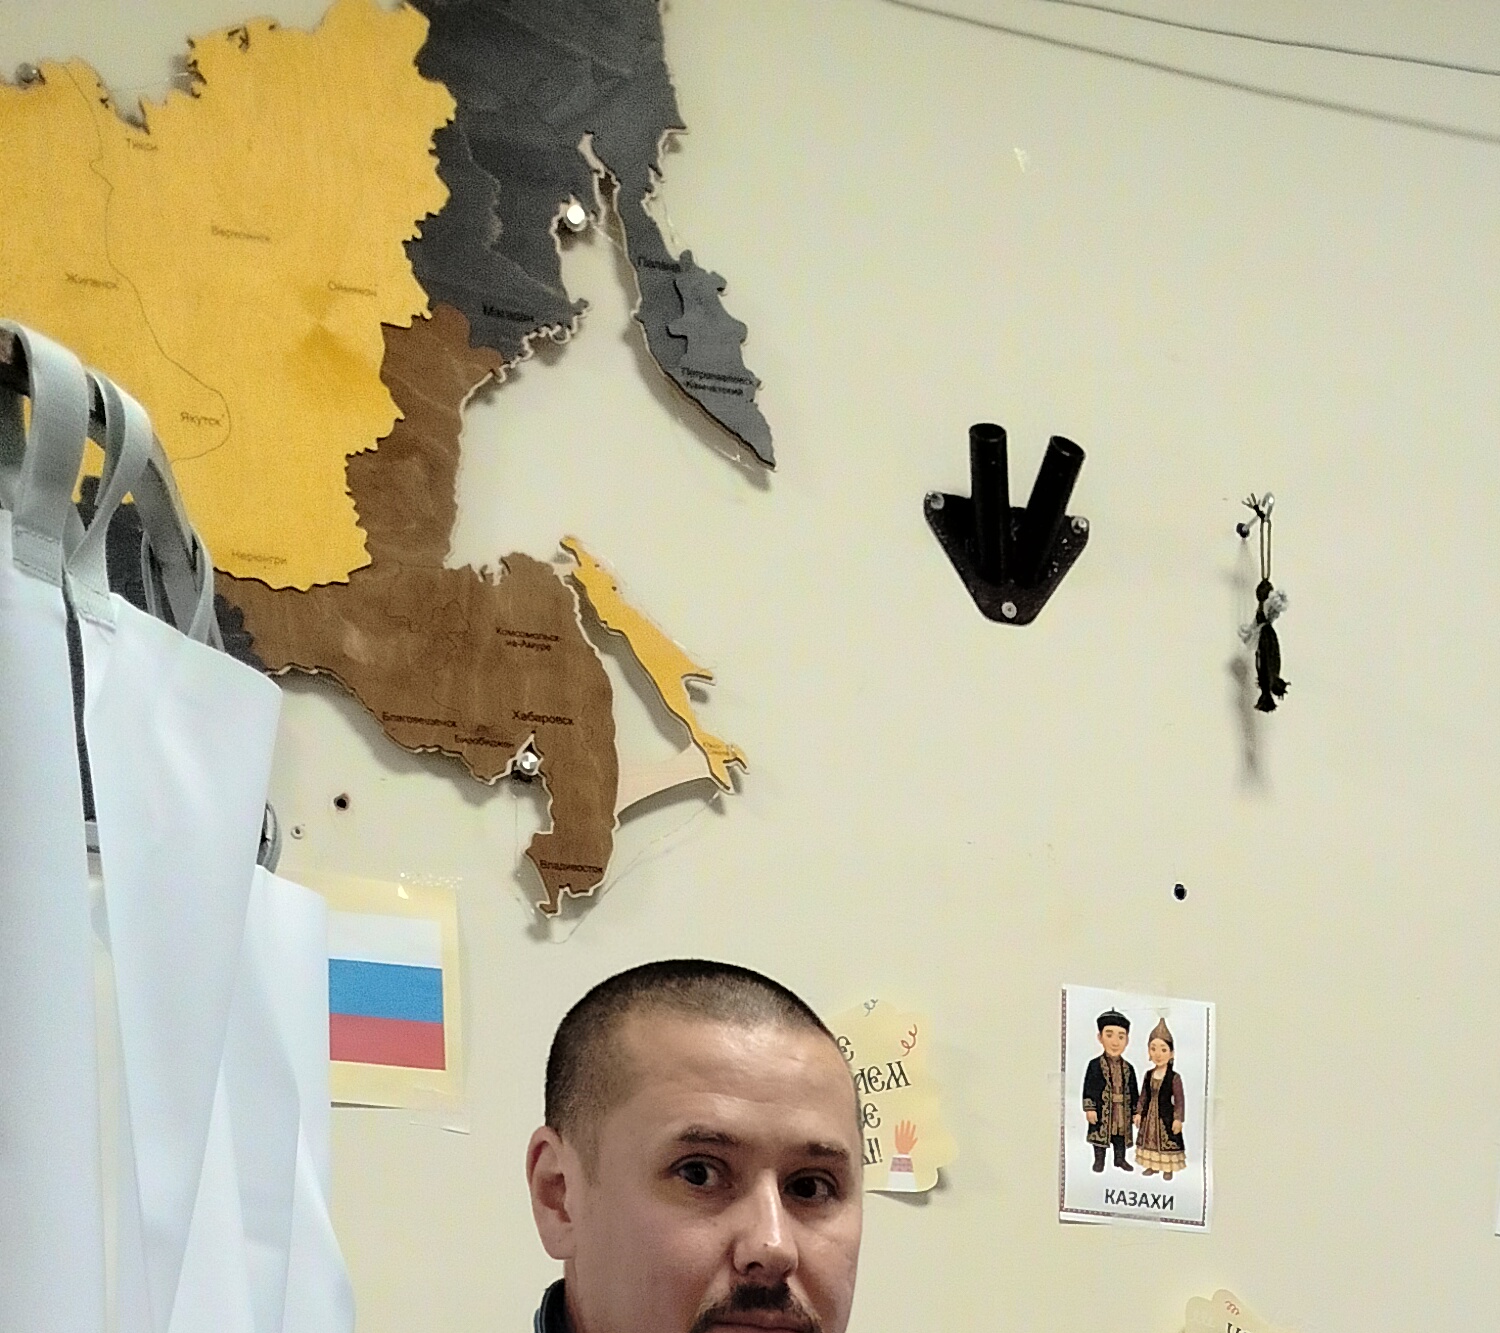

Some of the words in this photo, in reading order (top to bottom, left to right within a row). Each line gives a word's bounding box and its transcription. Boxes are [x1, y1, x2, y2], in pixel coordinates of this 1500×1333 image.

[512, 709, 574, 726] Хабаровск
[540, 859, 603, 873] Владивосток
[1104, 1189, 1174, 1211] КАЗАХИ
